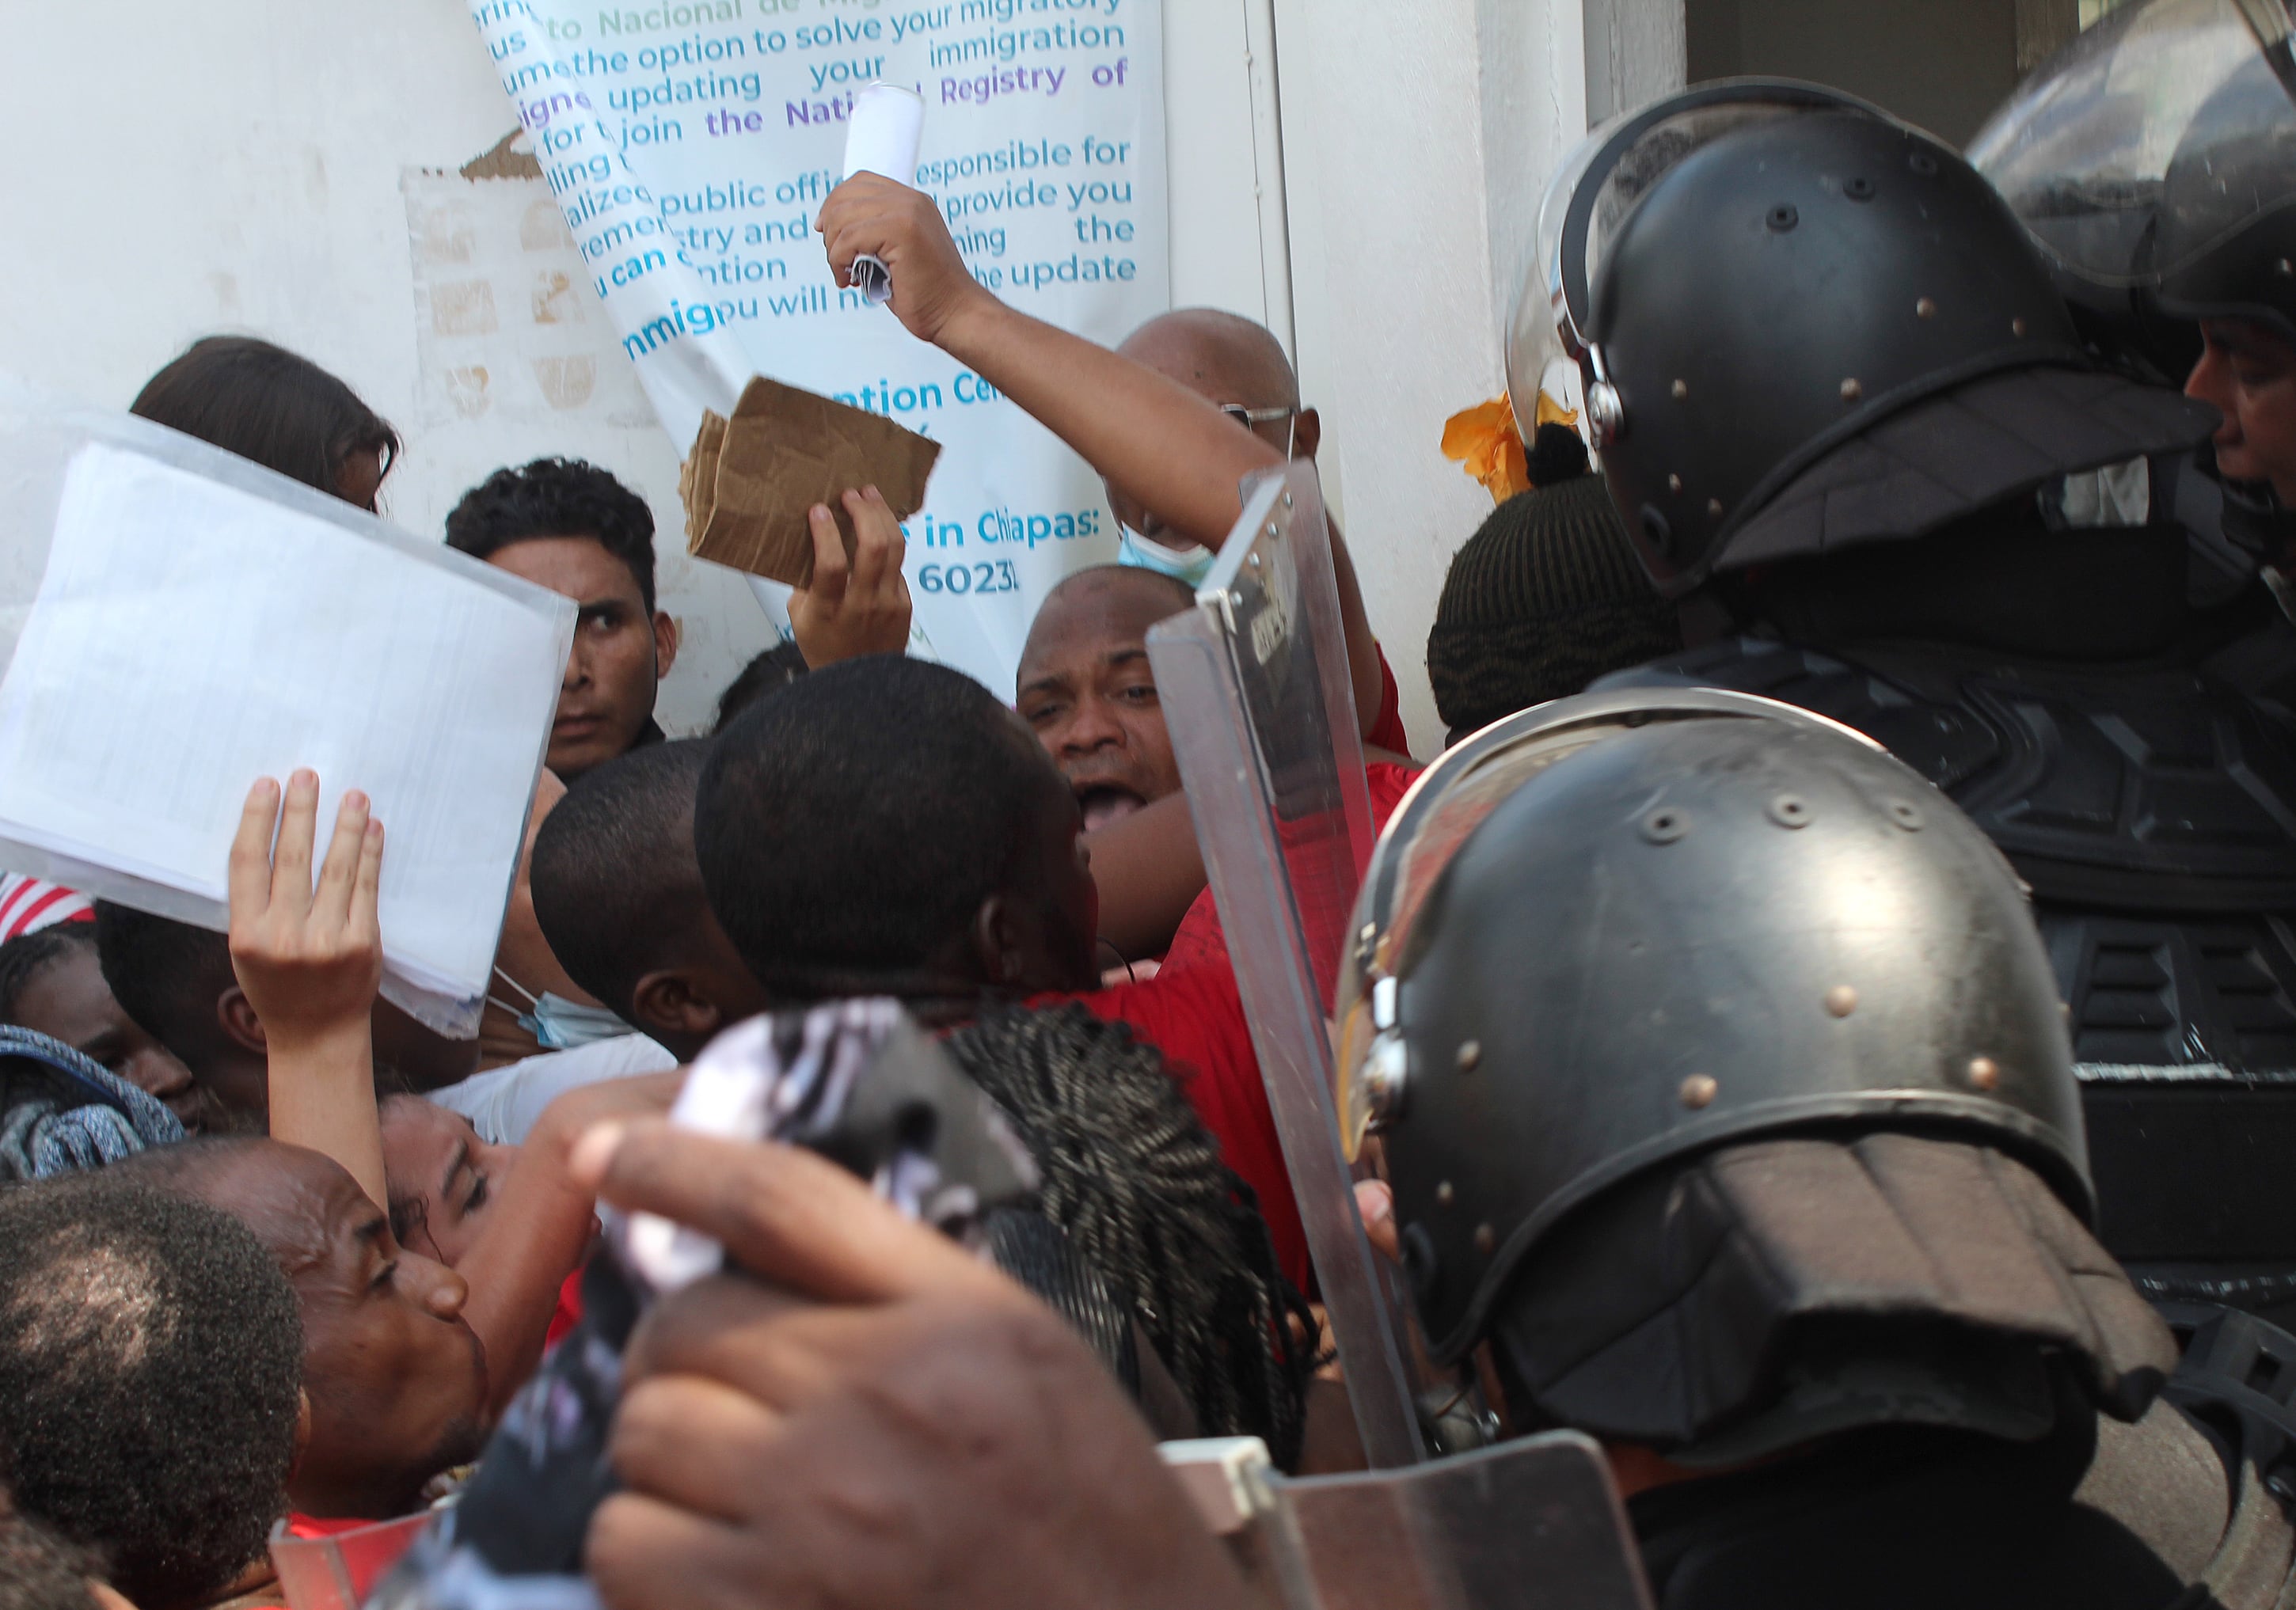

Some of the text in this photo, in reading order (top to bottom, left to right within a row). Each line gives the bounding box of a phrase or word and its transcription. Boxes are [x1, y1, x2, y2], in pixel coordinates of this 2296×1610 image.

[572, 47, 629, 76] the
[638, 32, 745, 74] option
[754, 28, 787, 55] to
[796, 14, 882, 49] solve
[890, 6, 952, 44] your
[598, 0, 743, 38] Nacional
[608, 17, 1124, 116] updating your immigration
[621, 113, 683, 150] join
[705, 107, 763, 137] the
[941, 64, 1066, 106] Registry
[1092, 55, 1128, 87] of
[543, 122, 585, 156] for
[660, 178, 766, 217] public
[1081, 135, 1131, 165] for
[744, 211, 809, 245] and
[946, 177, 1059, 226] provide
[1066, 180, 1132, 212] you
[1074, 214, 1135, 243] the
[611, 248, 667, 287] can
[768, 284, 828, 317] will
[1011, 253, 1136, 291] update
[925, 513, 964, 549] in
[977, 507, 1100, 550] Chiapas:
